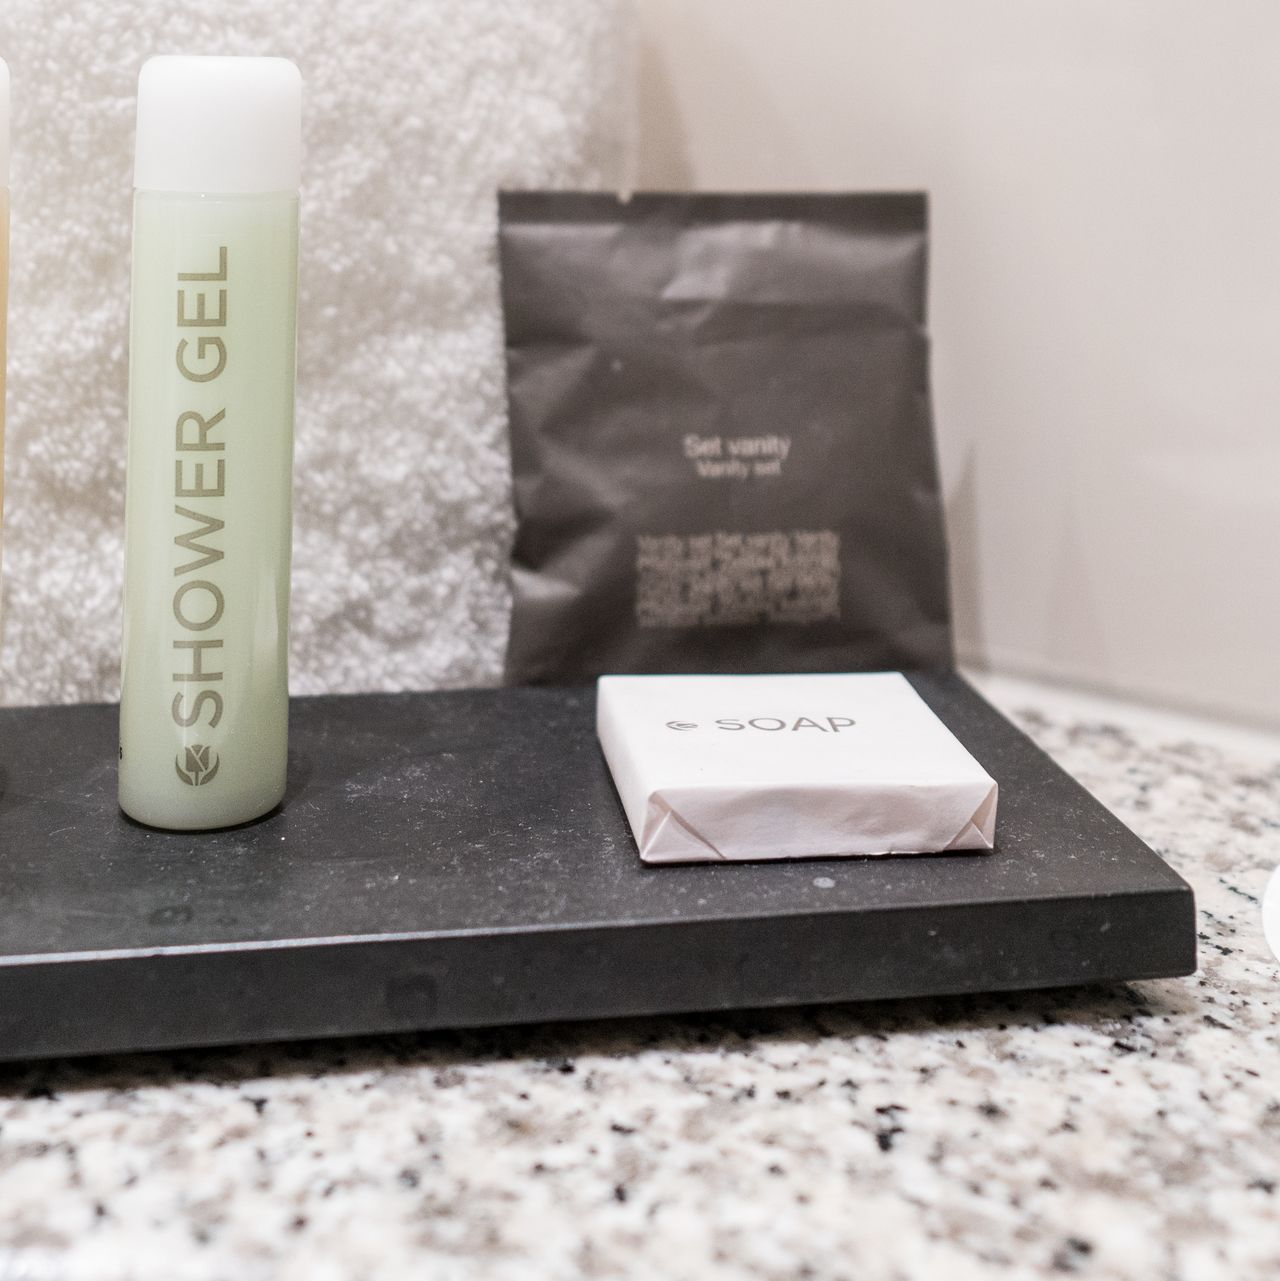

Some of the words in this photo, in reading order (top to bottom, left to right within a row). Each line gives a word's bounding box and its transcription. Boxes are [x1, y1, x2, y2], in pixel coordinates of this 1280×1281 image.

[176, 245, 229, 385] GEL
[172, 408, 226, 729] SHOWER
[714, 716, 857, 733] SOAP
